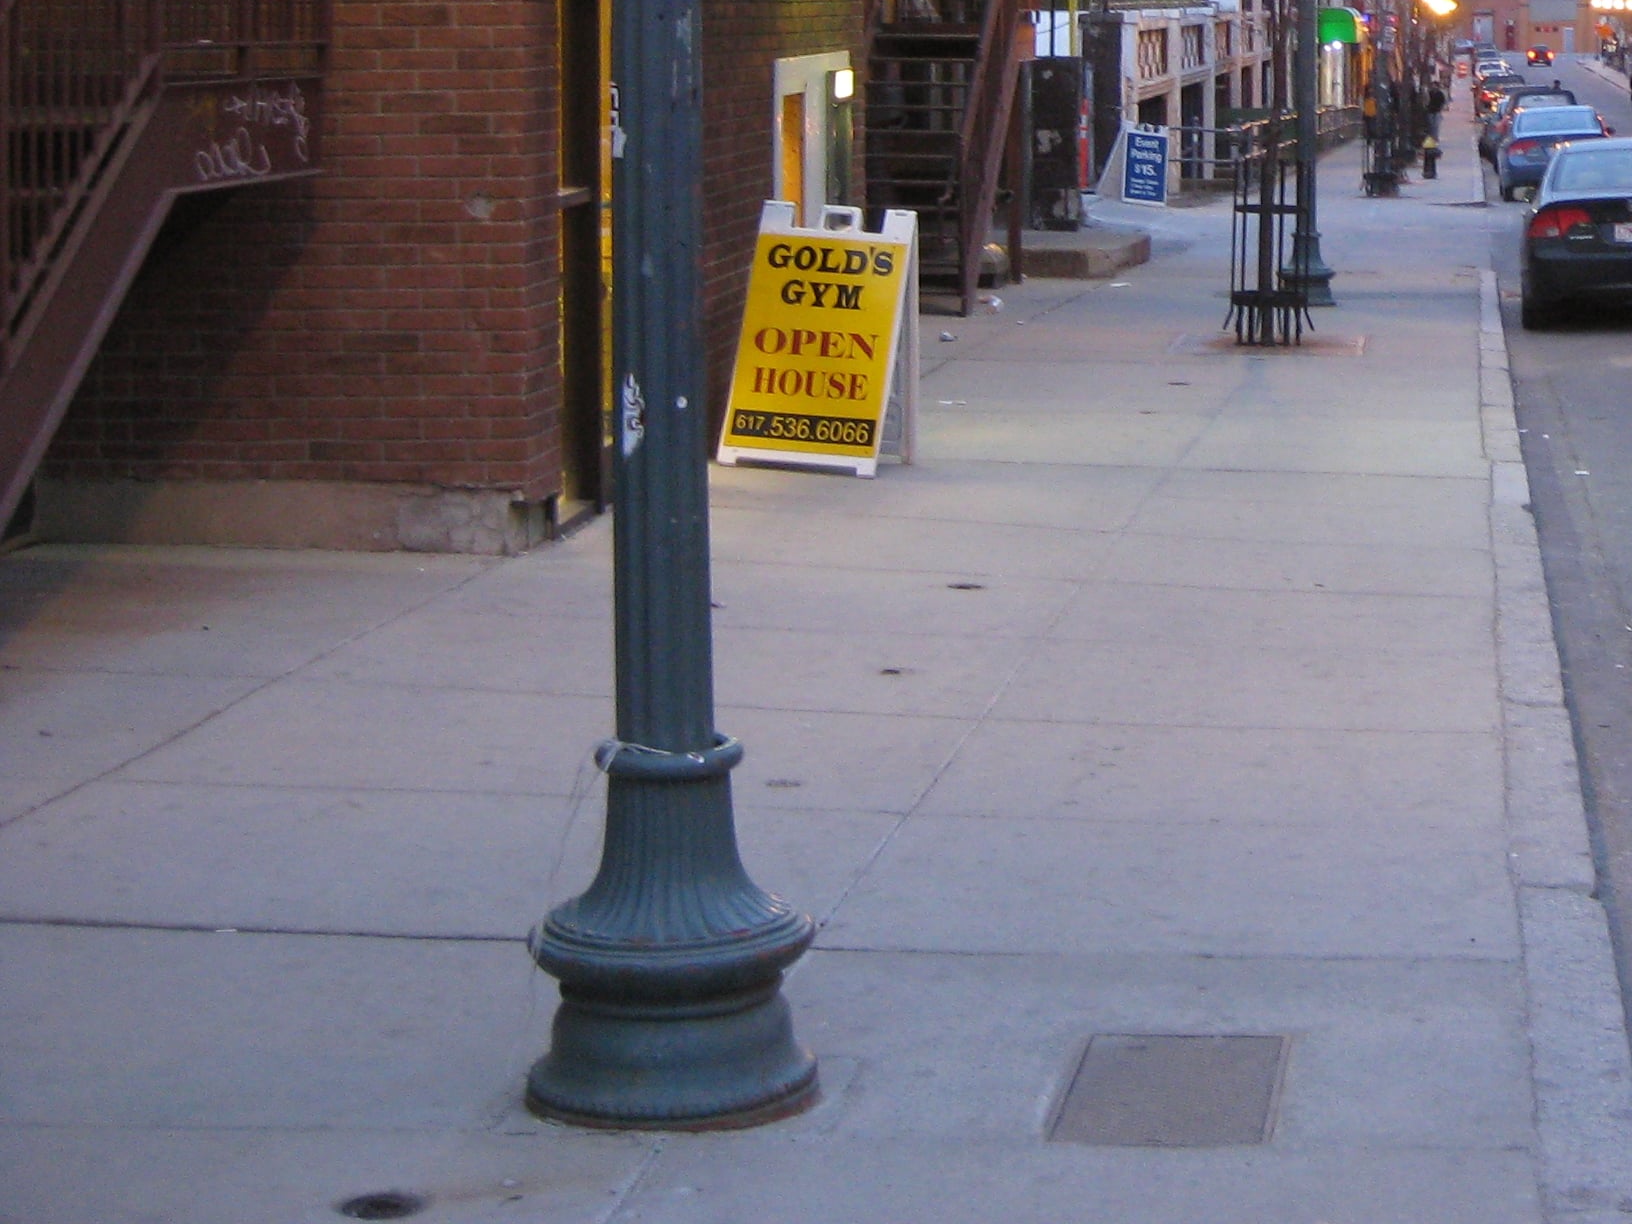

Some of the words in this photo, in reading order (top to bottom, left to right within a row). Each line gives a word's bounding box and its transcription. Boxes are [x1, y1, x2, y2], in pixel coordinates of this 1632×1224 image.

[768, 244, 895, 277] GOLD'S
[781, 279, 865, 311] GYM
[754, 327, 880, 361] OPEN
[751, 366, 869, 401] HOUSE
[735, 413, 870, 445] 617.536.6066
